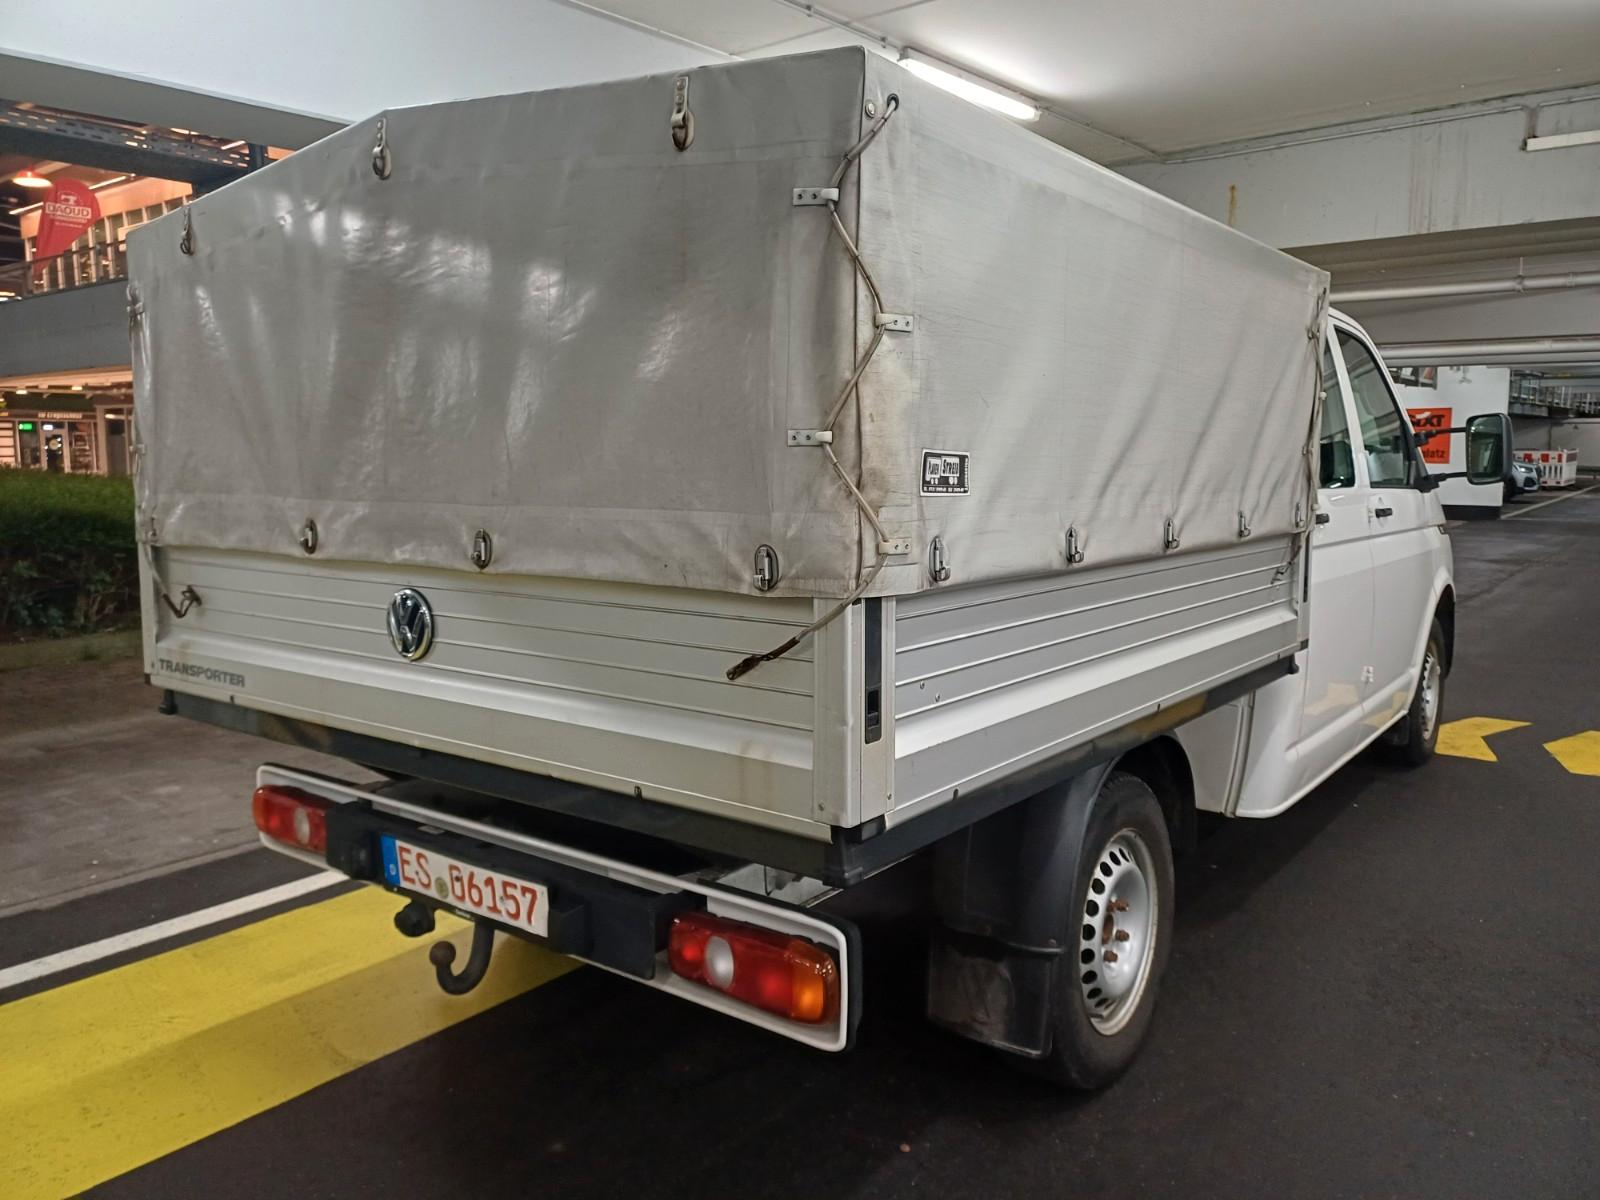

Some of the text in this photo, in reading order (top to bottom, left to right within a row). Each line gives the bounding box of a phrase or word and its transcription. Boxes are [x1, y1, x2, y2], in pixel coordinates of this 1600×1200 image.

[47, 203, 90, 217] DAOUD
[1409, 412, 1445, 427] SIXT
[159, 659, 245, 688] TRANSPORTER
[398, 845, 538, 926] ES 06157
